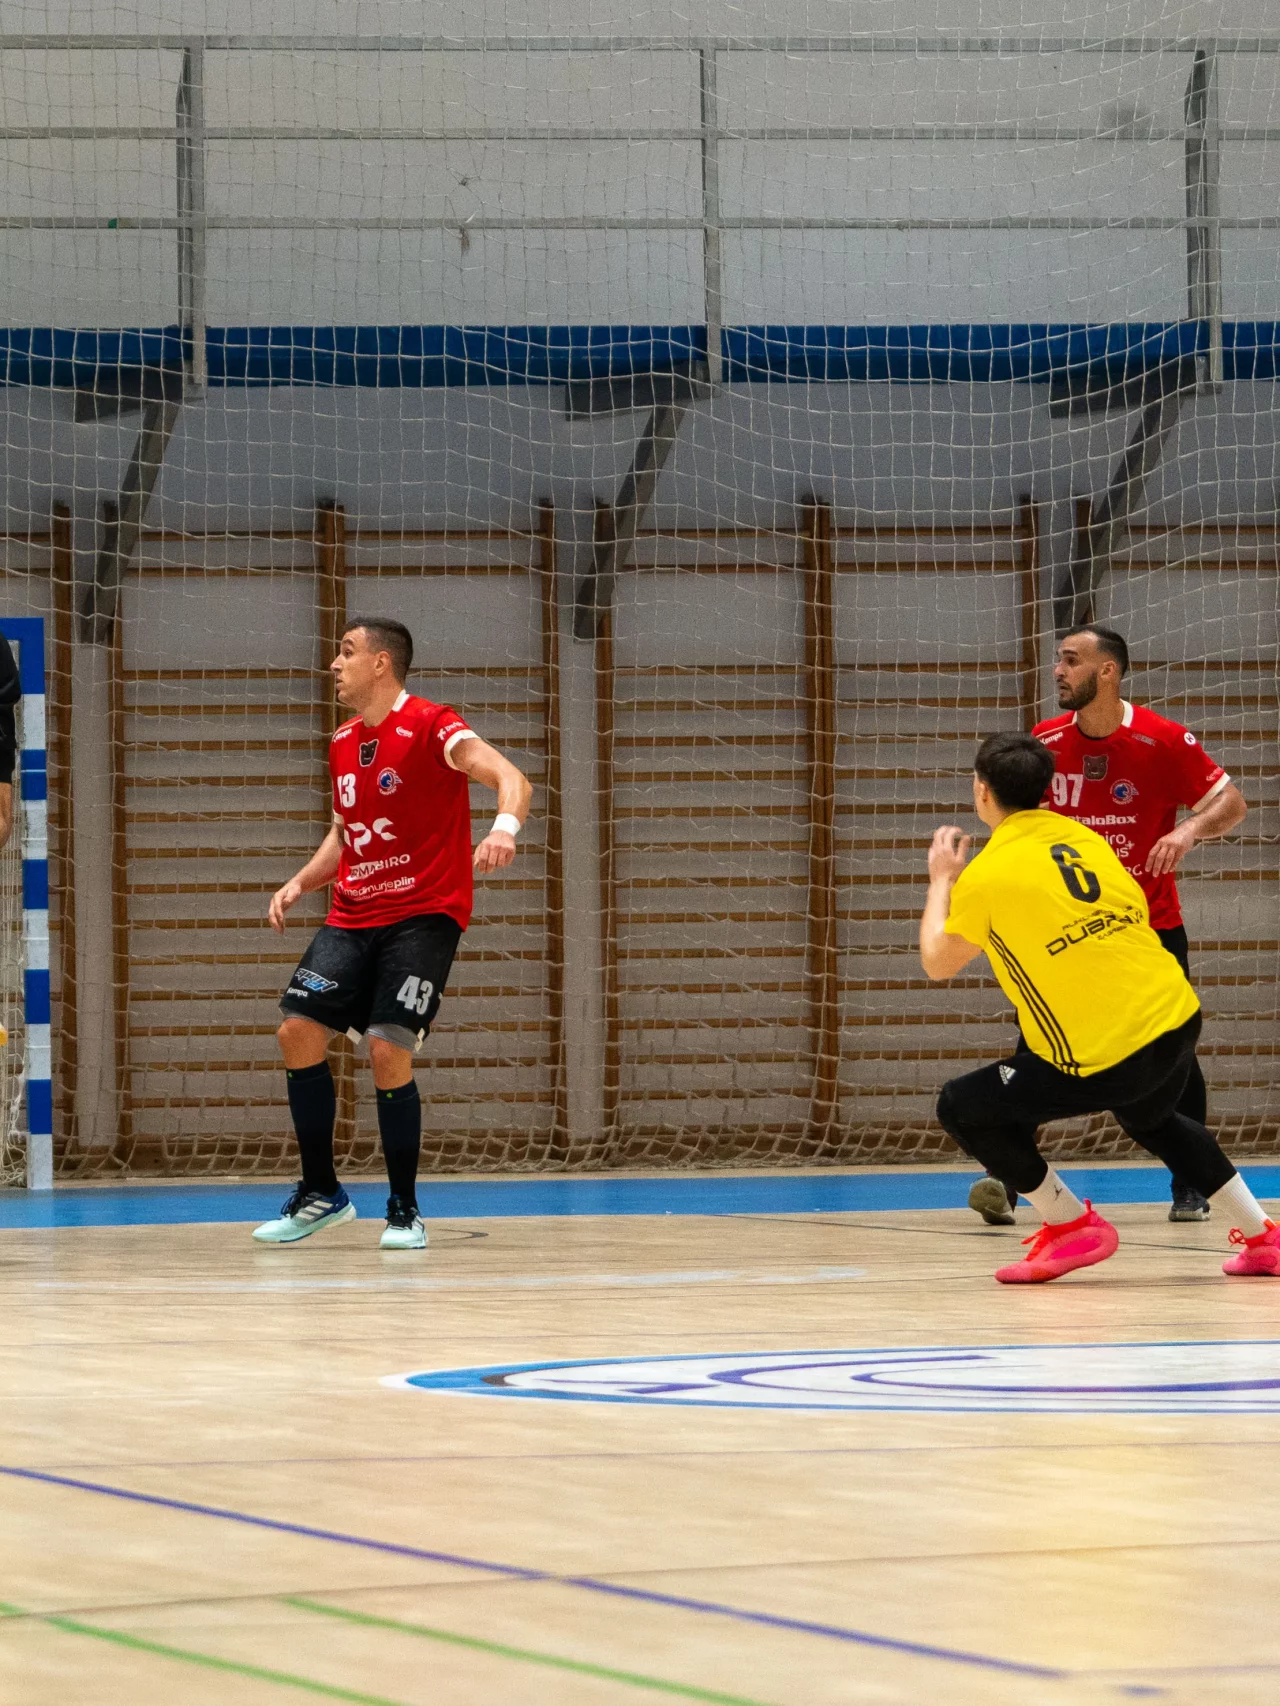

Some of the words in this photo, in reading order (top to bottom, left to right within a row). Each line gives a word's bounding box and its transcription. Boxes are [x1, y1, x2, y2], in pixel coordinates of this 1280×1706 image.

[1051, 772, 1084, 808] 97
[1049, 843, 1102, 904] 6
[397, 975, 434, 1015] 43
